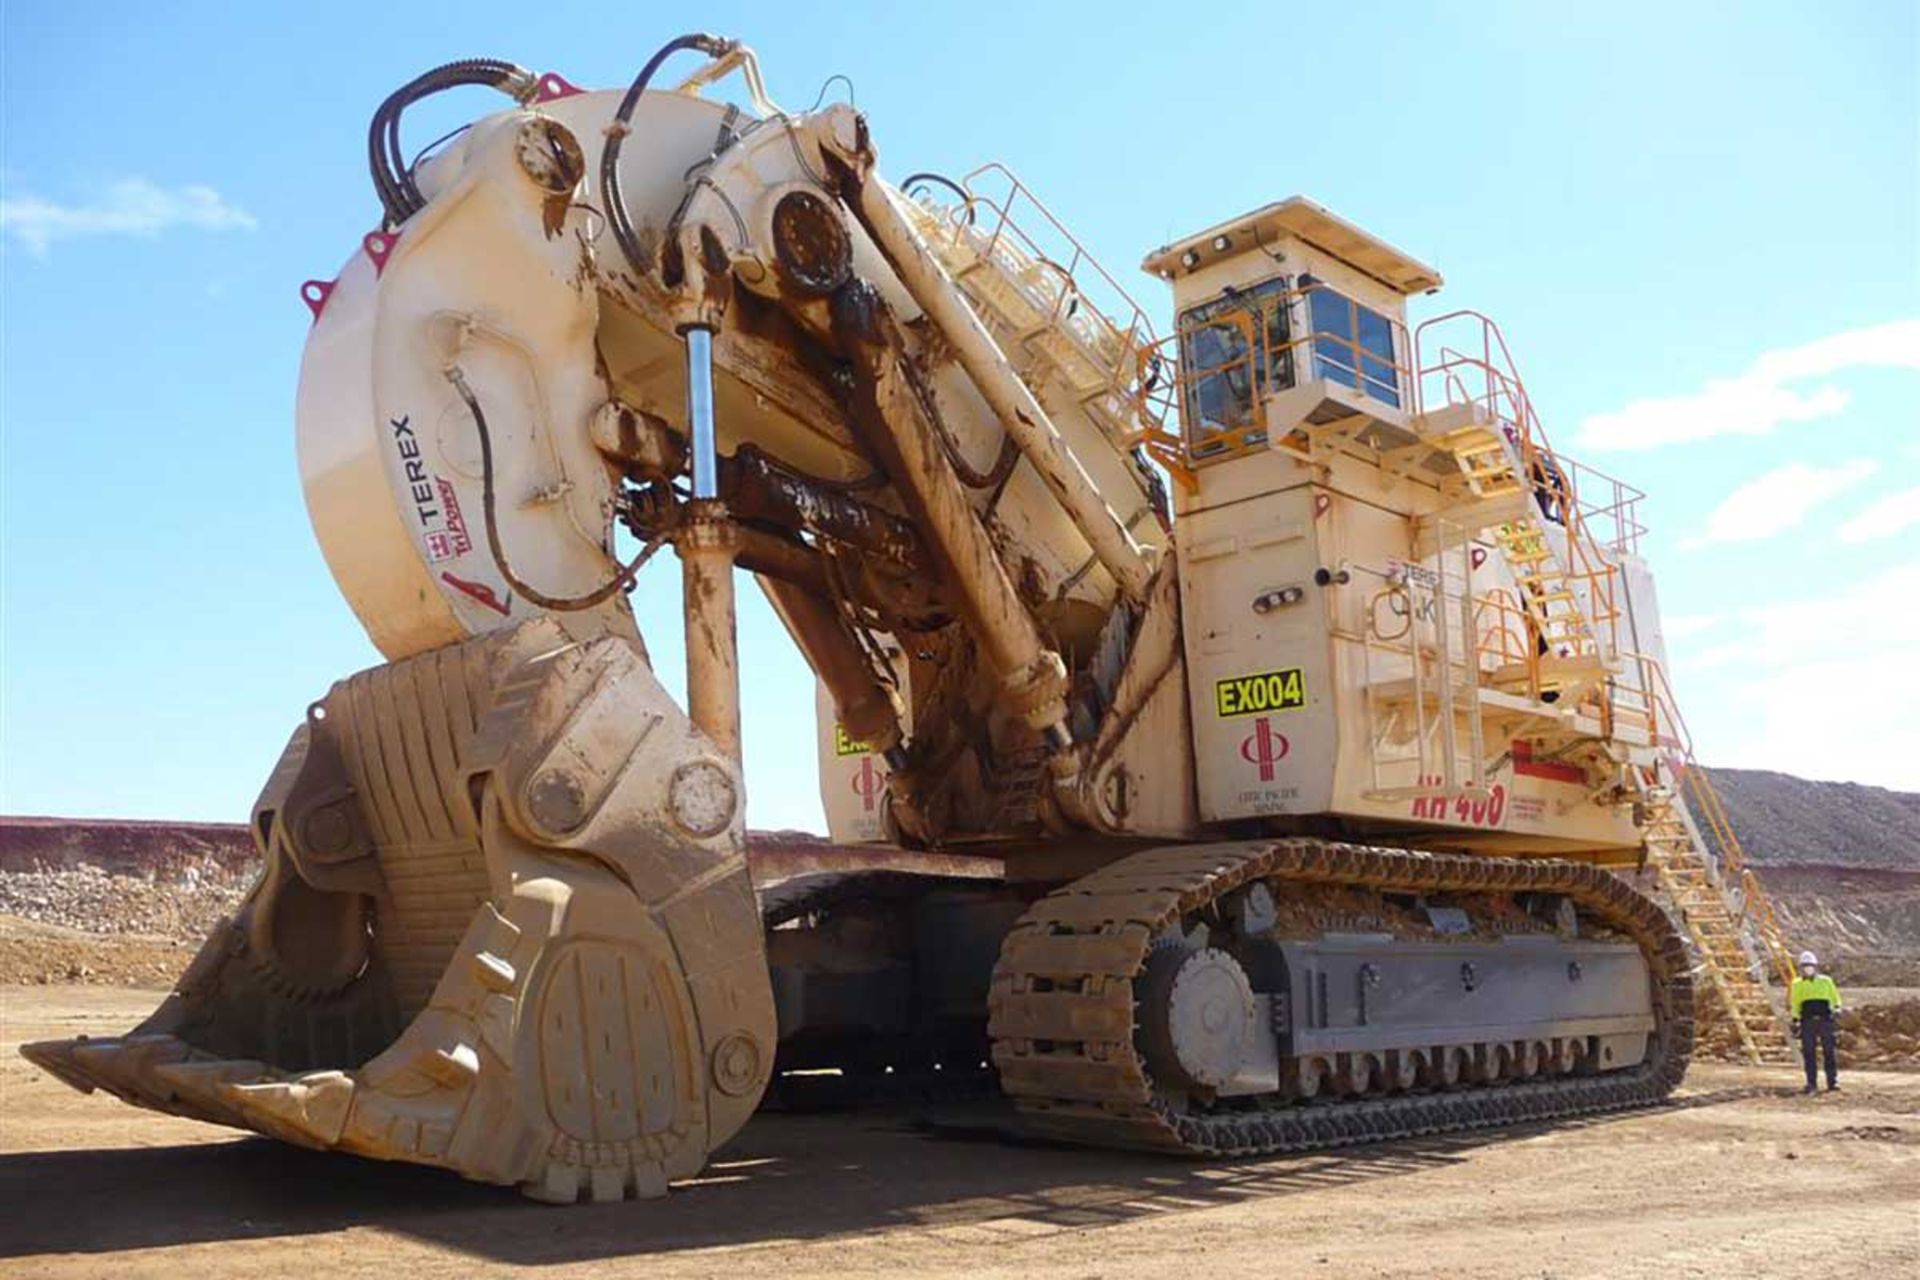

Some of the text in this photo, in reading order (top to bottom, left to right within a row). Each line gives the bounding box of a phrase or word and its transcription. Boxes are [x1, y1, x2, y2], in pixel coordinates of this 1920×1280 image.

[390, 415, 439, 526] TEREX
[1218, 671, 1302, 714] EX004
[1455, 783, 1504, 827] 400
